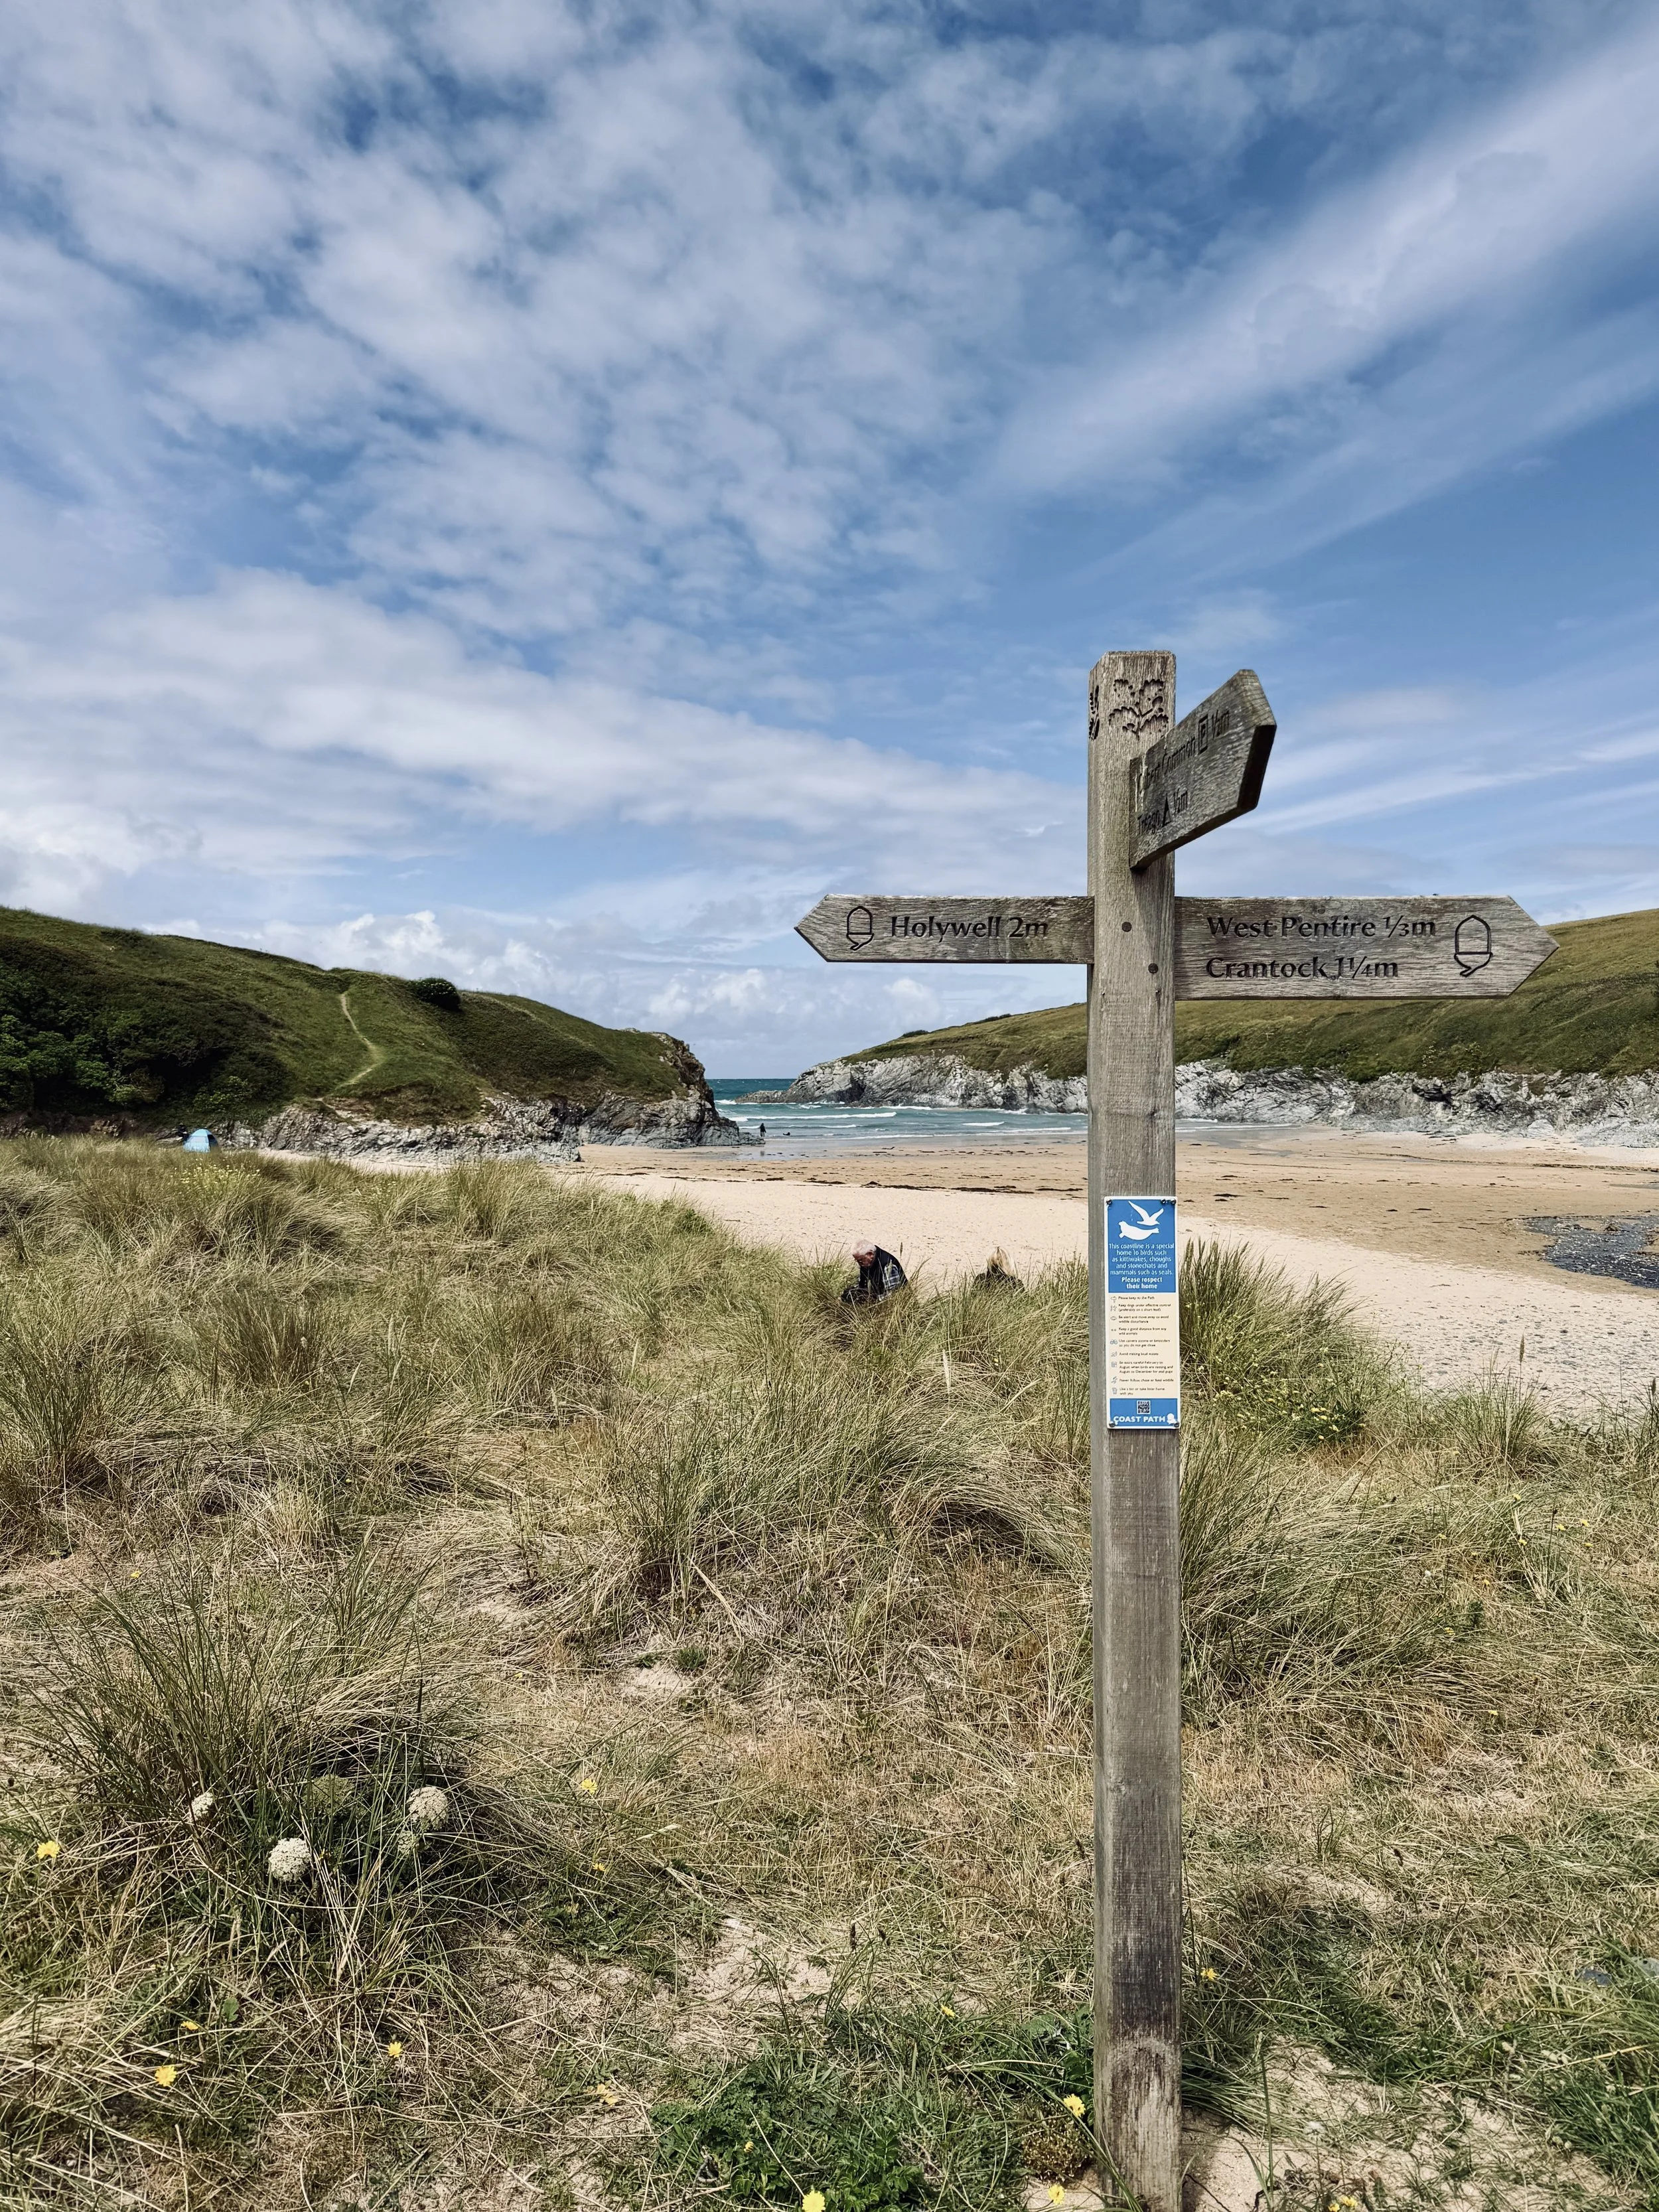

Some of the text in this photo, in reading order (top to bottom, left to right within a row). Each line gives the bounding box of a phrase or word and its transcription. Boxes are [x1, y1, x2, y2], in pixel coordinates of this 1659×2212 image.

[891, 915, 1048, 943] Holywell 2m
[1206, 916, 1274, 939] West
[1281, 915, 1376, 939] Pentire
[1205, 956, 1327, 979] Crantock
